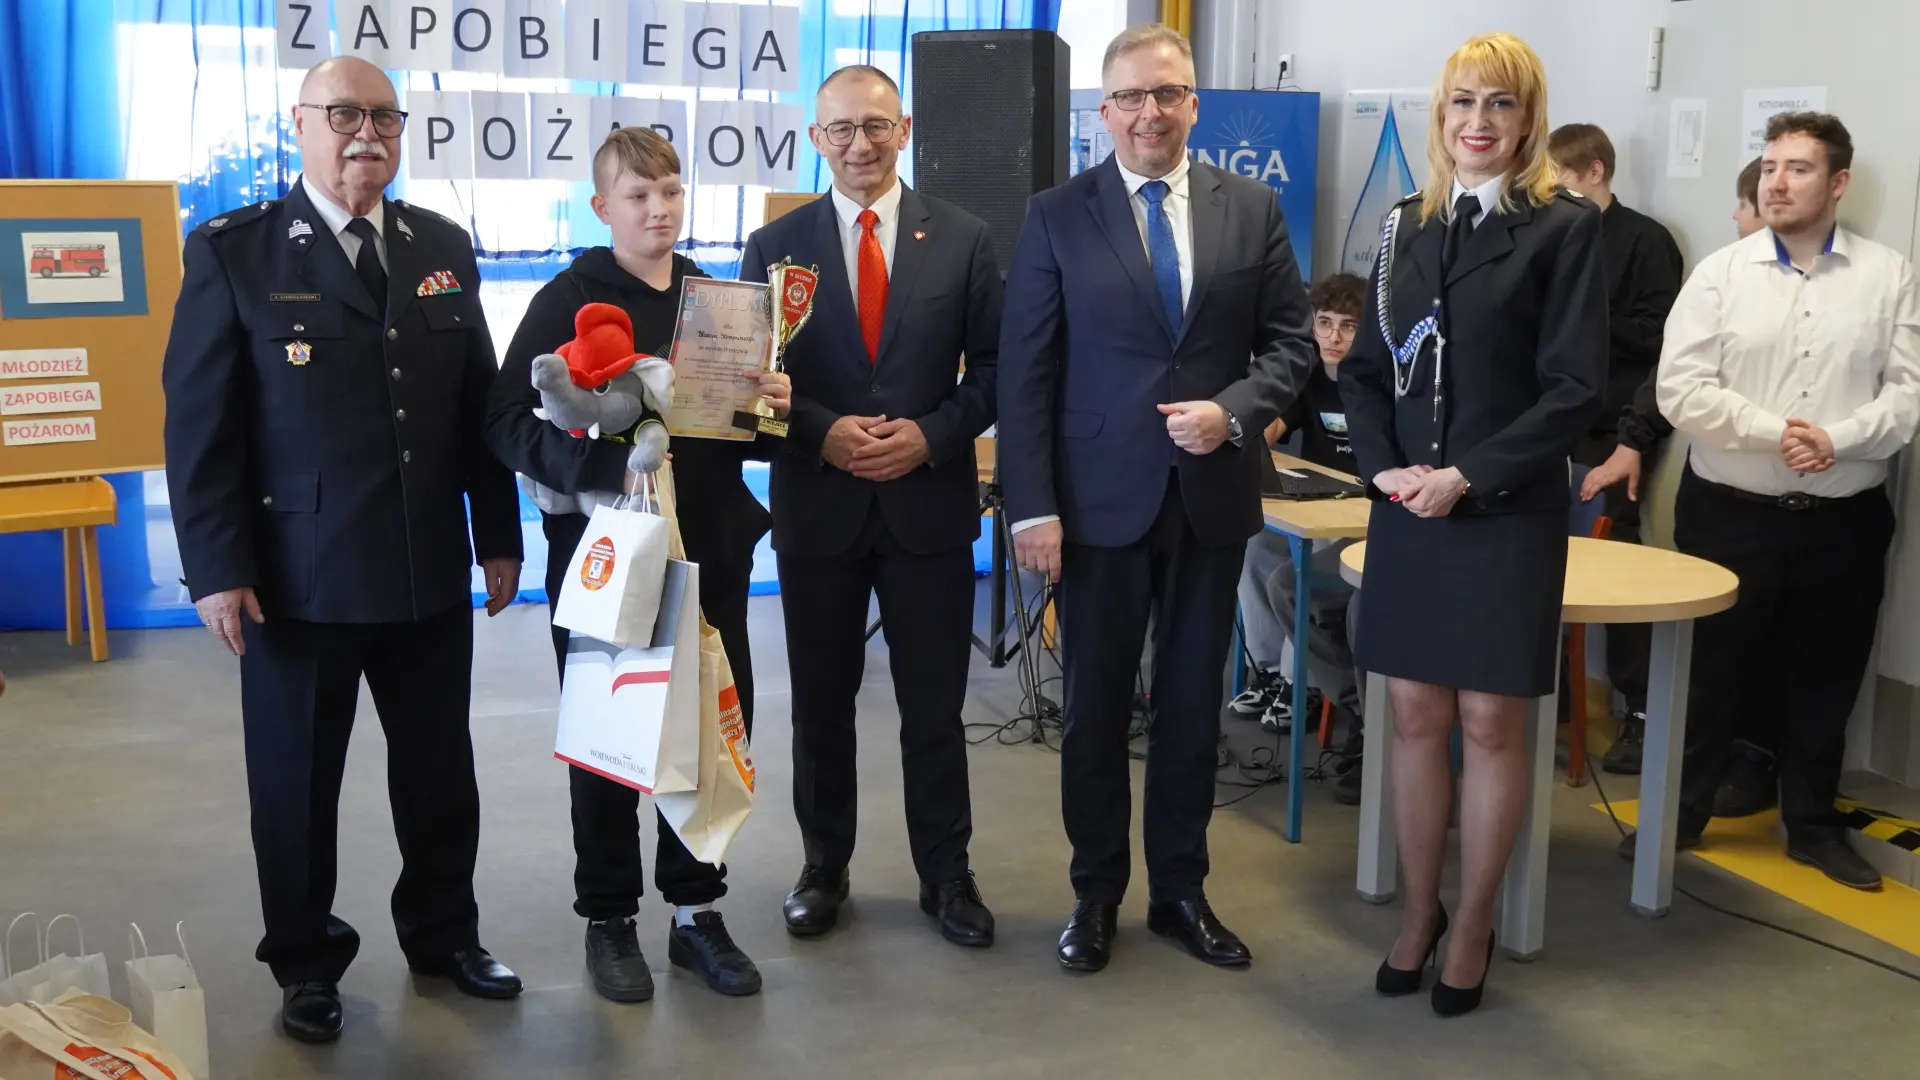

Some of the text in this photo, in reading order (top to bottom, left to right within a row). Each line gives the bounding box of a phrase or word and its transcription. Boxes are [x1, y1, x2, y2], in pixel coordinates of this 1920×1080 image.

[290, 4, 787, 73] ZAPOBIEGA
[427, 108, 797, 171] POŻOM
[2, 356, 84, 374] MŁODZIEŻ
[4, 388, 96, 407] ZAPOBIEGA
[8, 422, 91, 440] POŻAROM
[590, 748, 623, 768] WOJEWODA
